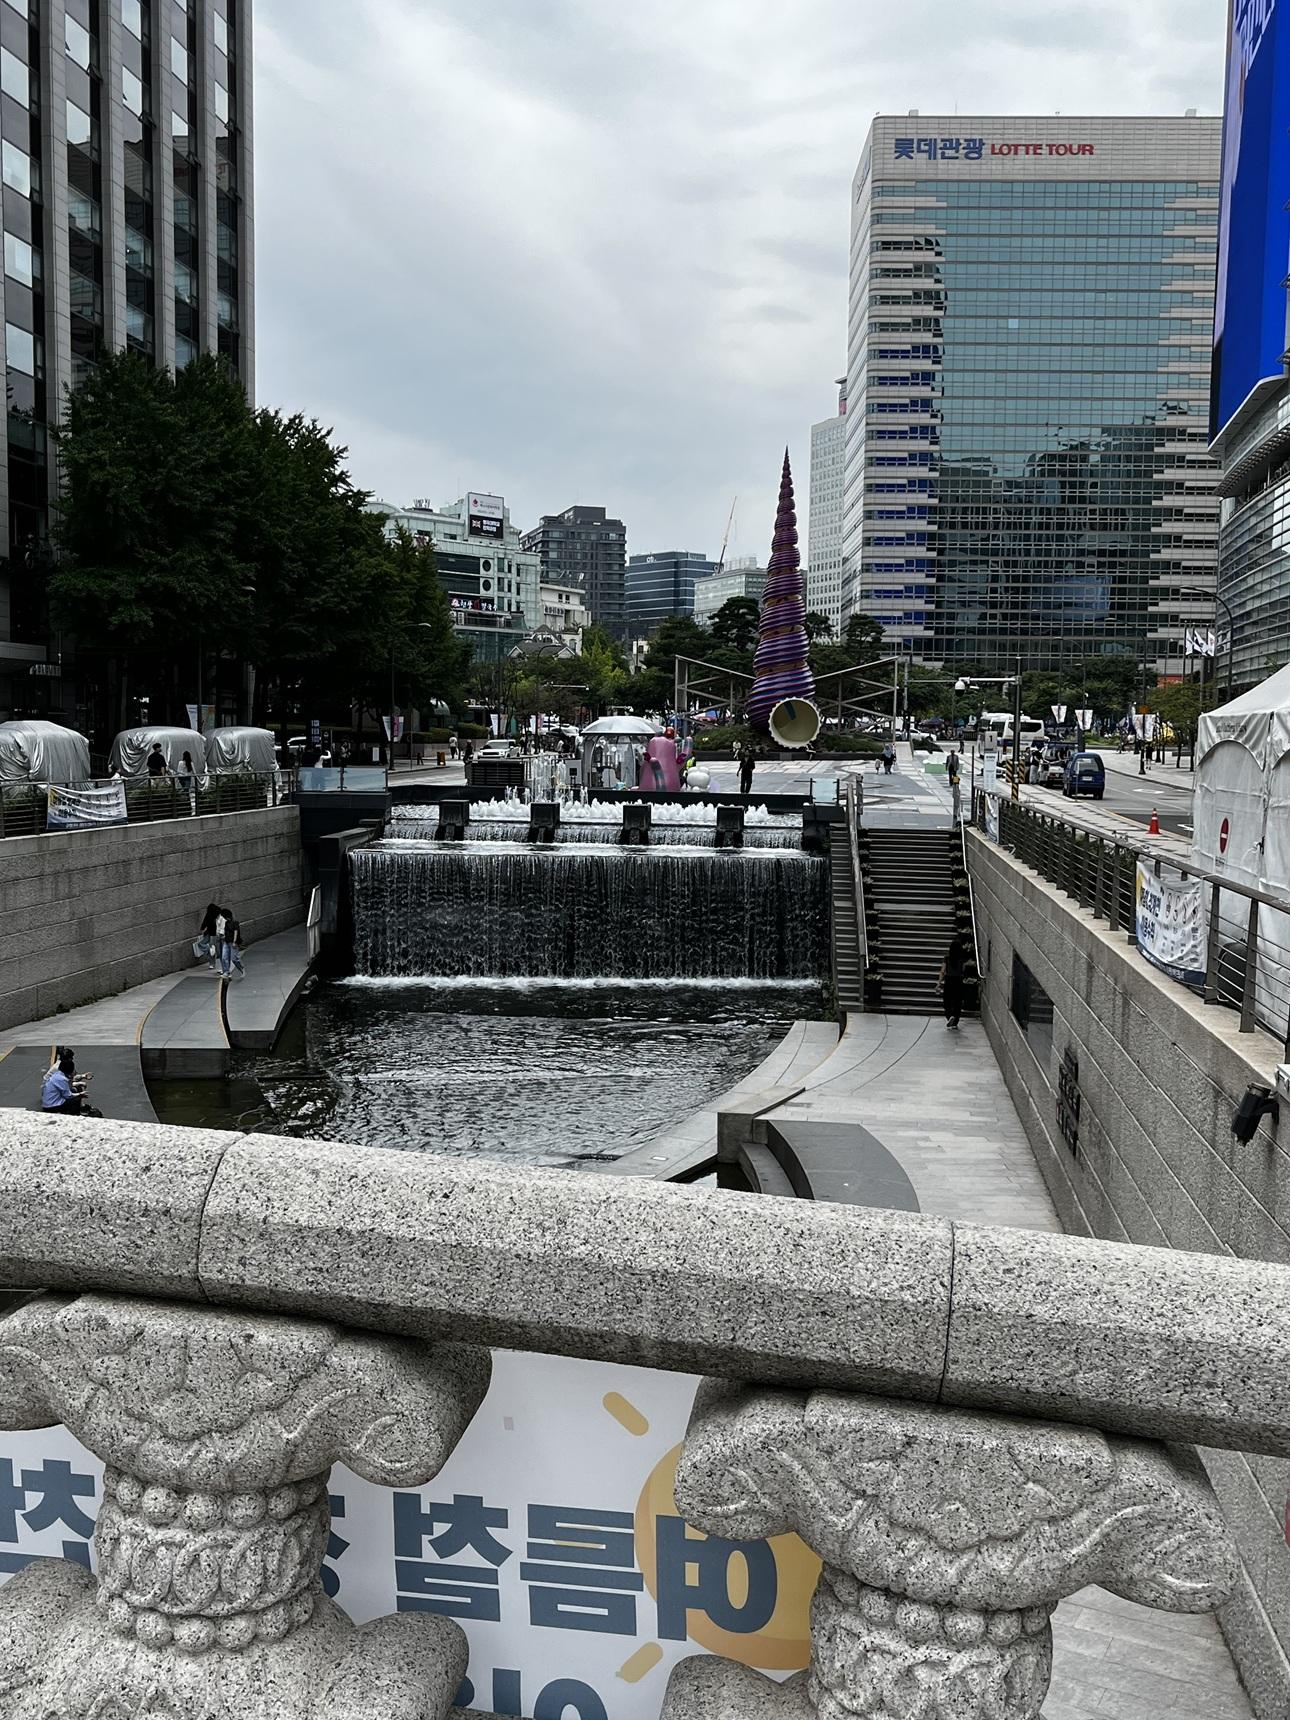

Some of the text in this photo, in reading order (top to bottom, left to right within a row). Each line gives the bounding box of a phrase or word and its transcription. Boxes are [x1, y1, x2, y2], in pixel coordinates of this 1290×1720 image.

[894, 138, 1095, 161] 롯데관광 LOTTE TOUR
